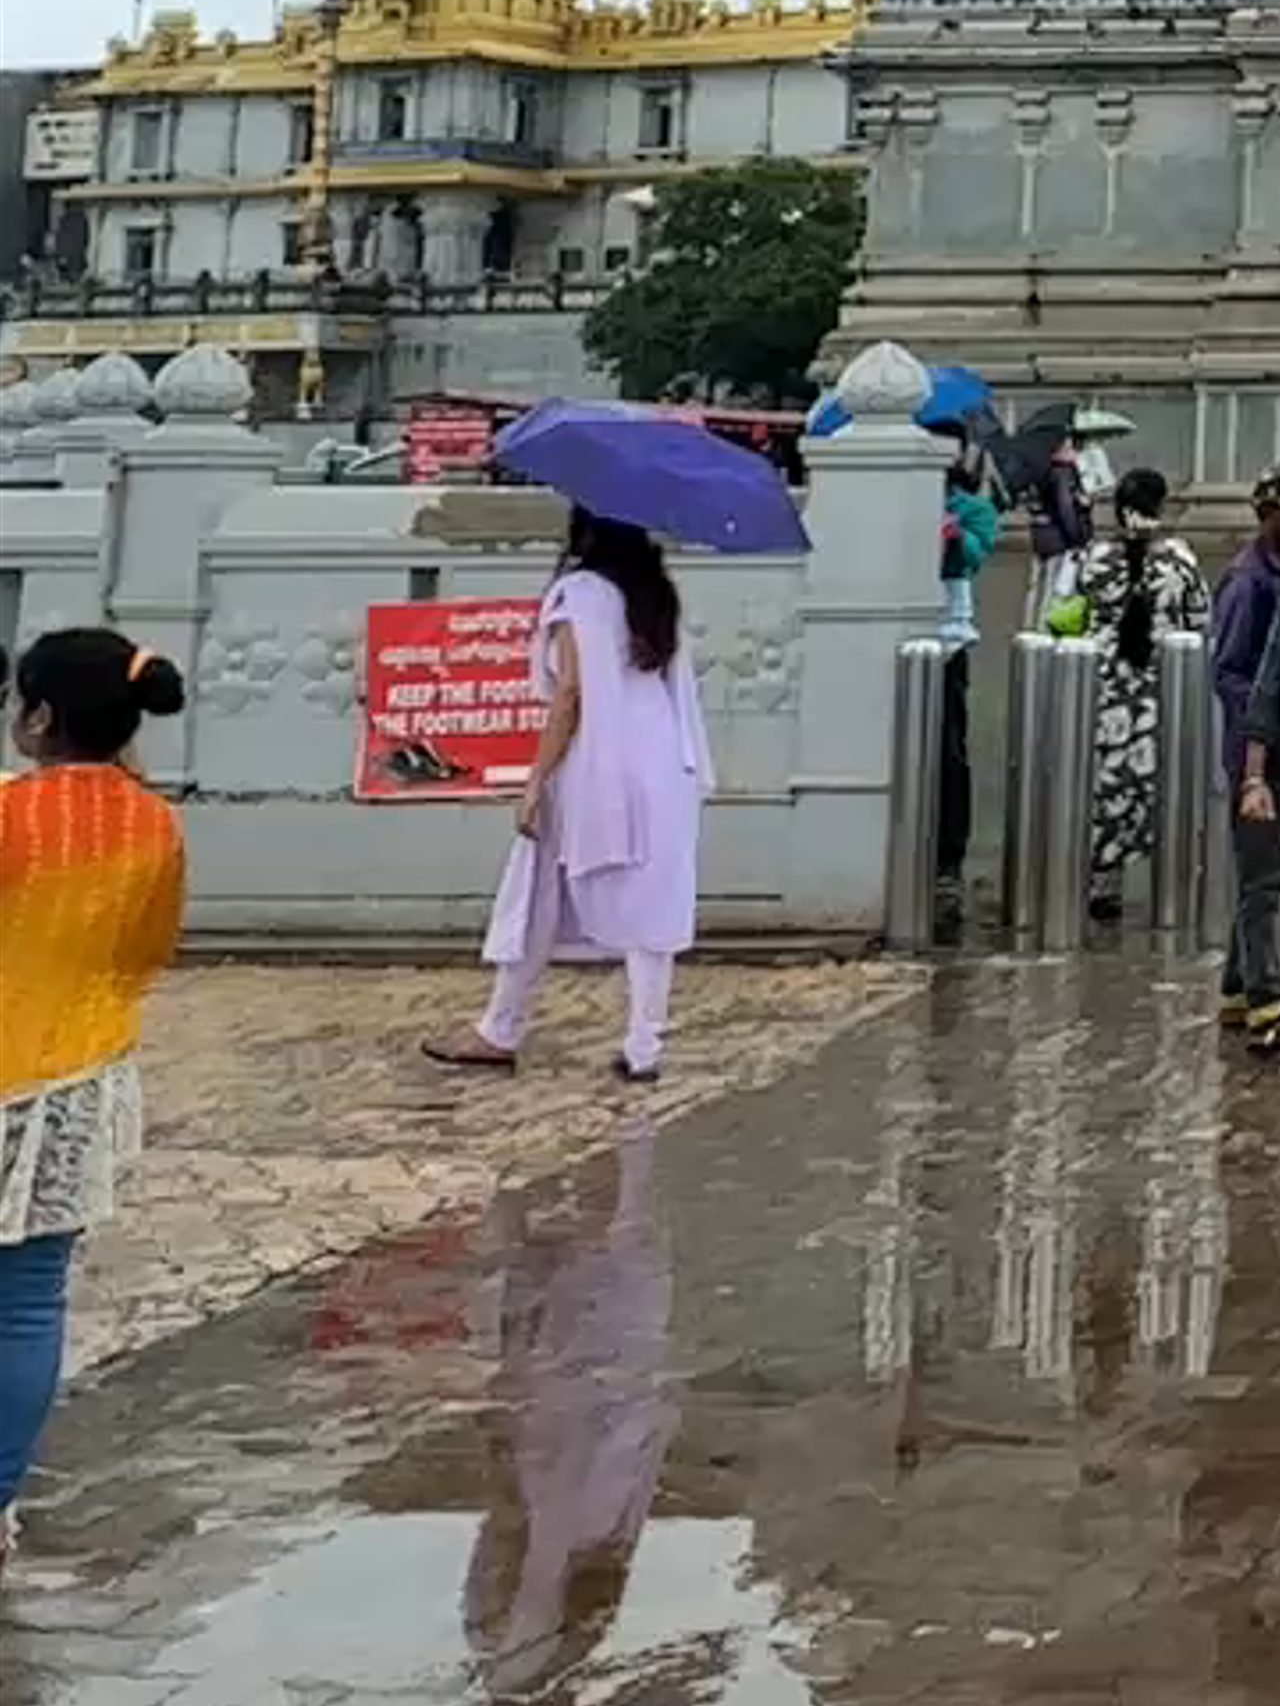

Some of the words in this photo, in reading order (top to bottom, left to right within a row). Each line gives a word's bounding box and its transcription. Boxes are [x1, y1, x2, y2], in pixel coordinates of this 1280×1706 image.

[387, 682, 436, 708] KEEP
[440, 681, 475, 705] THE
[371, 712, 408, 737] THE
[411, 708, 512, 736] FOOTWEAR
